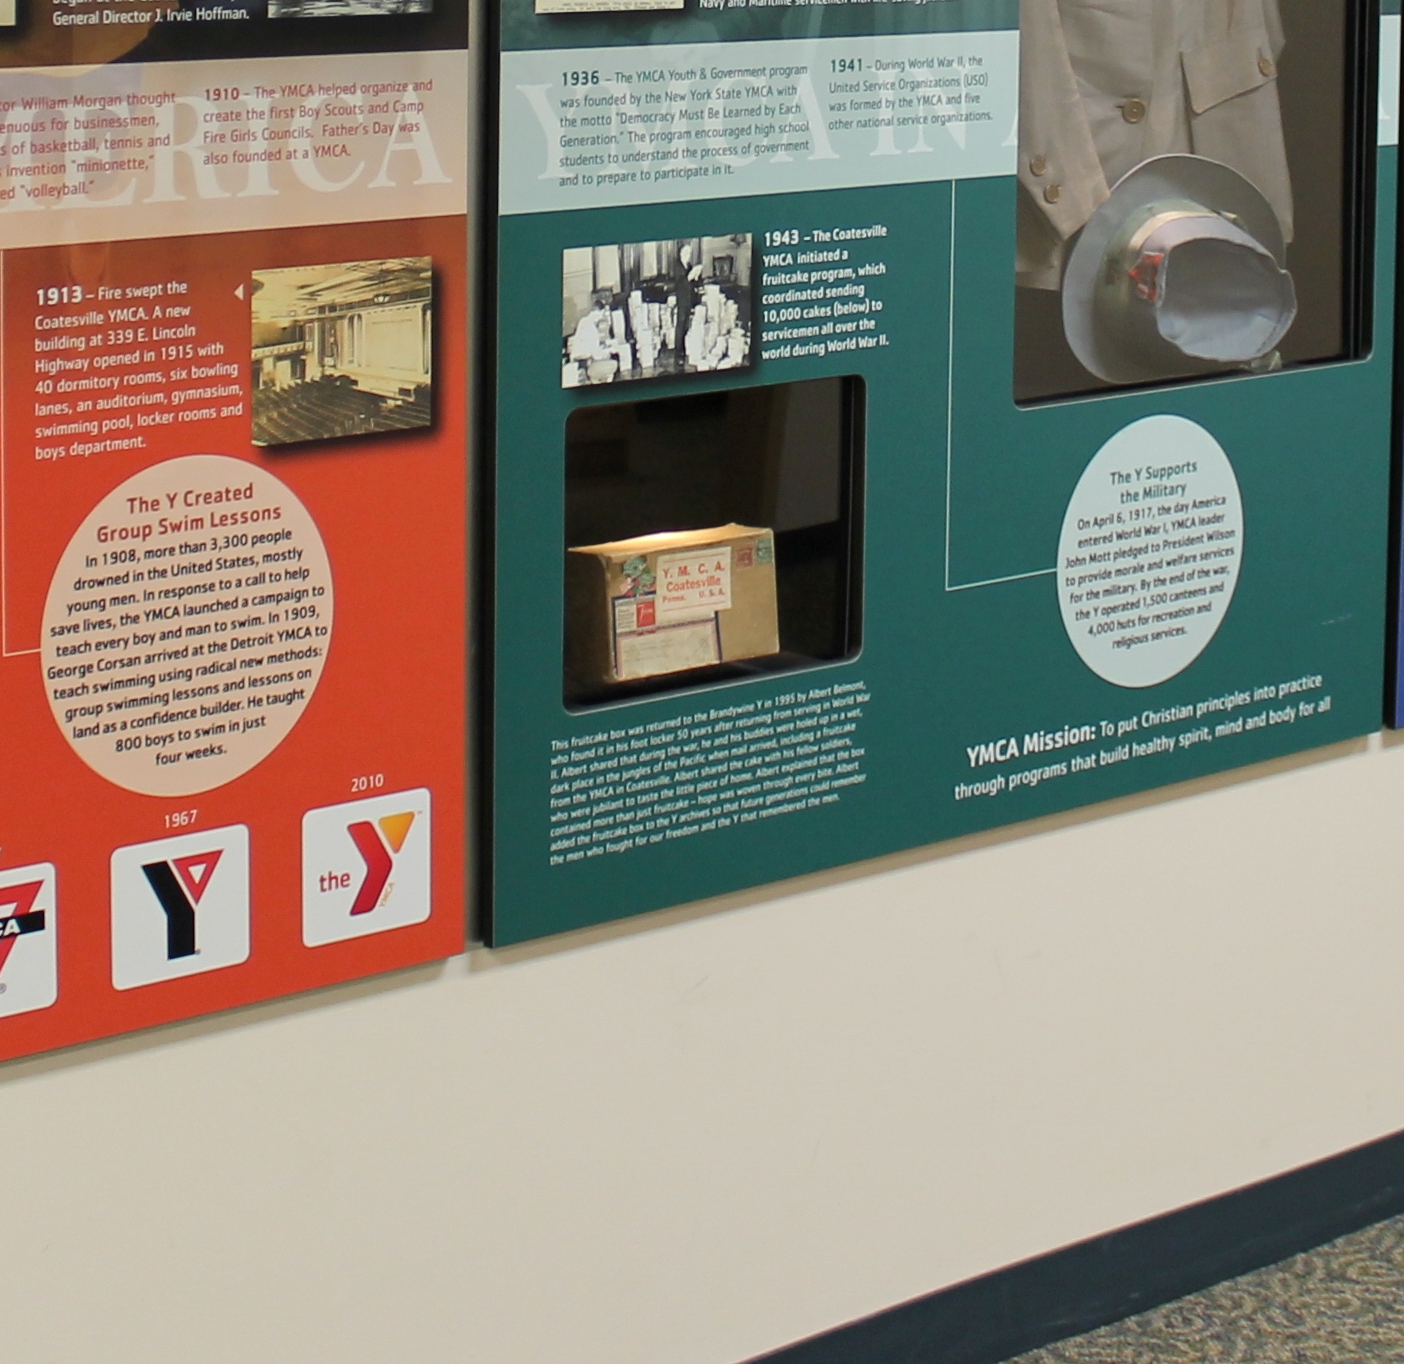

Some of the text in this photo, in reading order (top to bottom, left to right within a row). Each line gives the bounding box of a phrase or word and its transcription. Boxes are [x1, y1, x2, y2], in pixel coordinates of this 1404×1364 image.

[202, 143, 351, 166] also founded at a YMCA.
[760, 333, 890, 360] world during World War II.
[1109, 460, 1197, 486] The Y Supports
[125, 481, 254, 515] The Y Created
[1119, 483, 1187, 505] the Military
[96, 506, 282, 544] Group Swim Lessons
[665, 574, 722, 593] Coatesville
[966, 674, 1323, 768] YMCA Mission: To put Christian principles into practice
[350, 772, 384, 793] 2010
[164, 808, 198, 829] 1967
[318, 870, 351, 893] the
